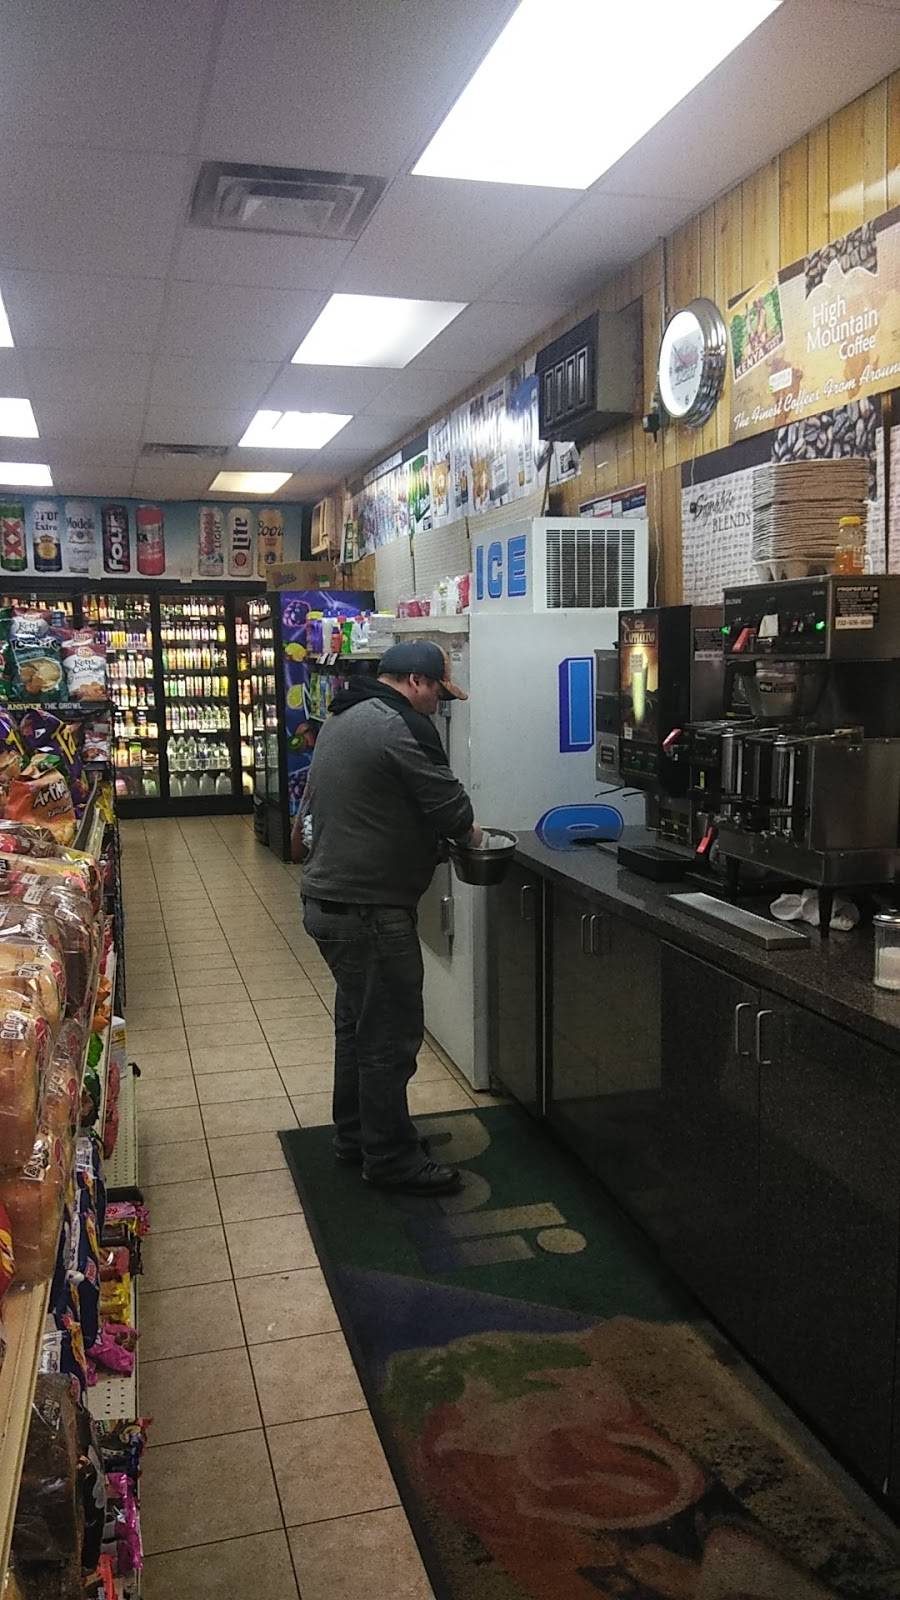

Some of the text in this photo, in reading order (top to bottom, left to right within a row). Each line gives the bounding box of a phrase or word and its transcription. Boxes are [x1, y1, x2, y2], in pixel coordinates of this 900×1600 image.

[812, 294, 847, 329] High
[807, 306, 879, 353] Mountain
[735, 347, 764, 377] KENYA
[839, 333, 876, 360] Coffee
[733, 411, 750, 431] The
[751, 398, 783, 424] Finest
[214, 520, 222, 549] LIGHT
[232, 517, 252, 551] Lite
[711, 511, 751, 533] BLENDS
[476, 534, 527, 601] ICE
[7, 703, 41, 711] ANSWER
